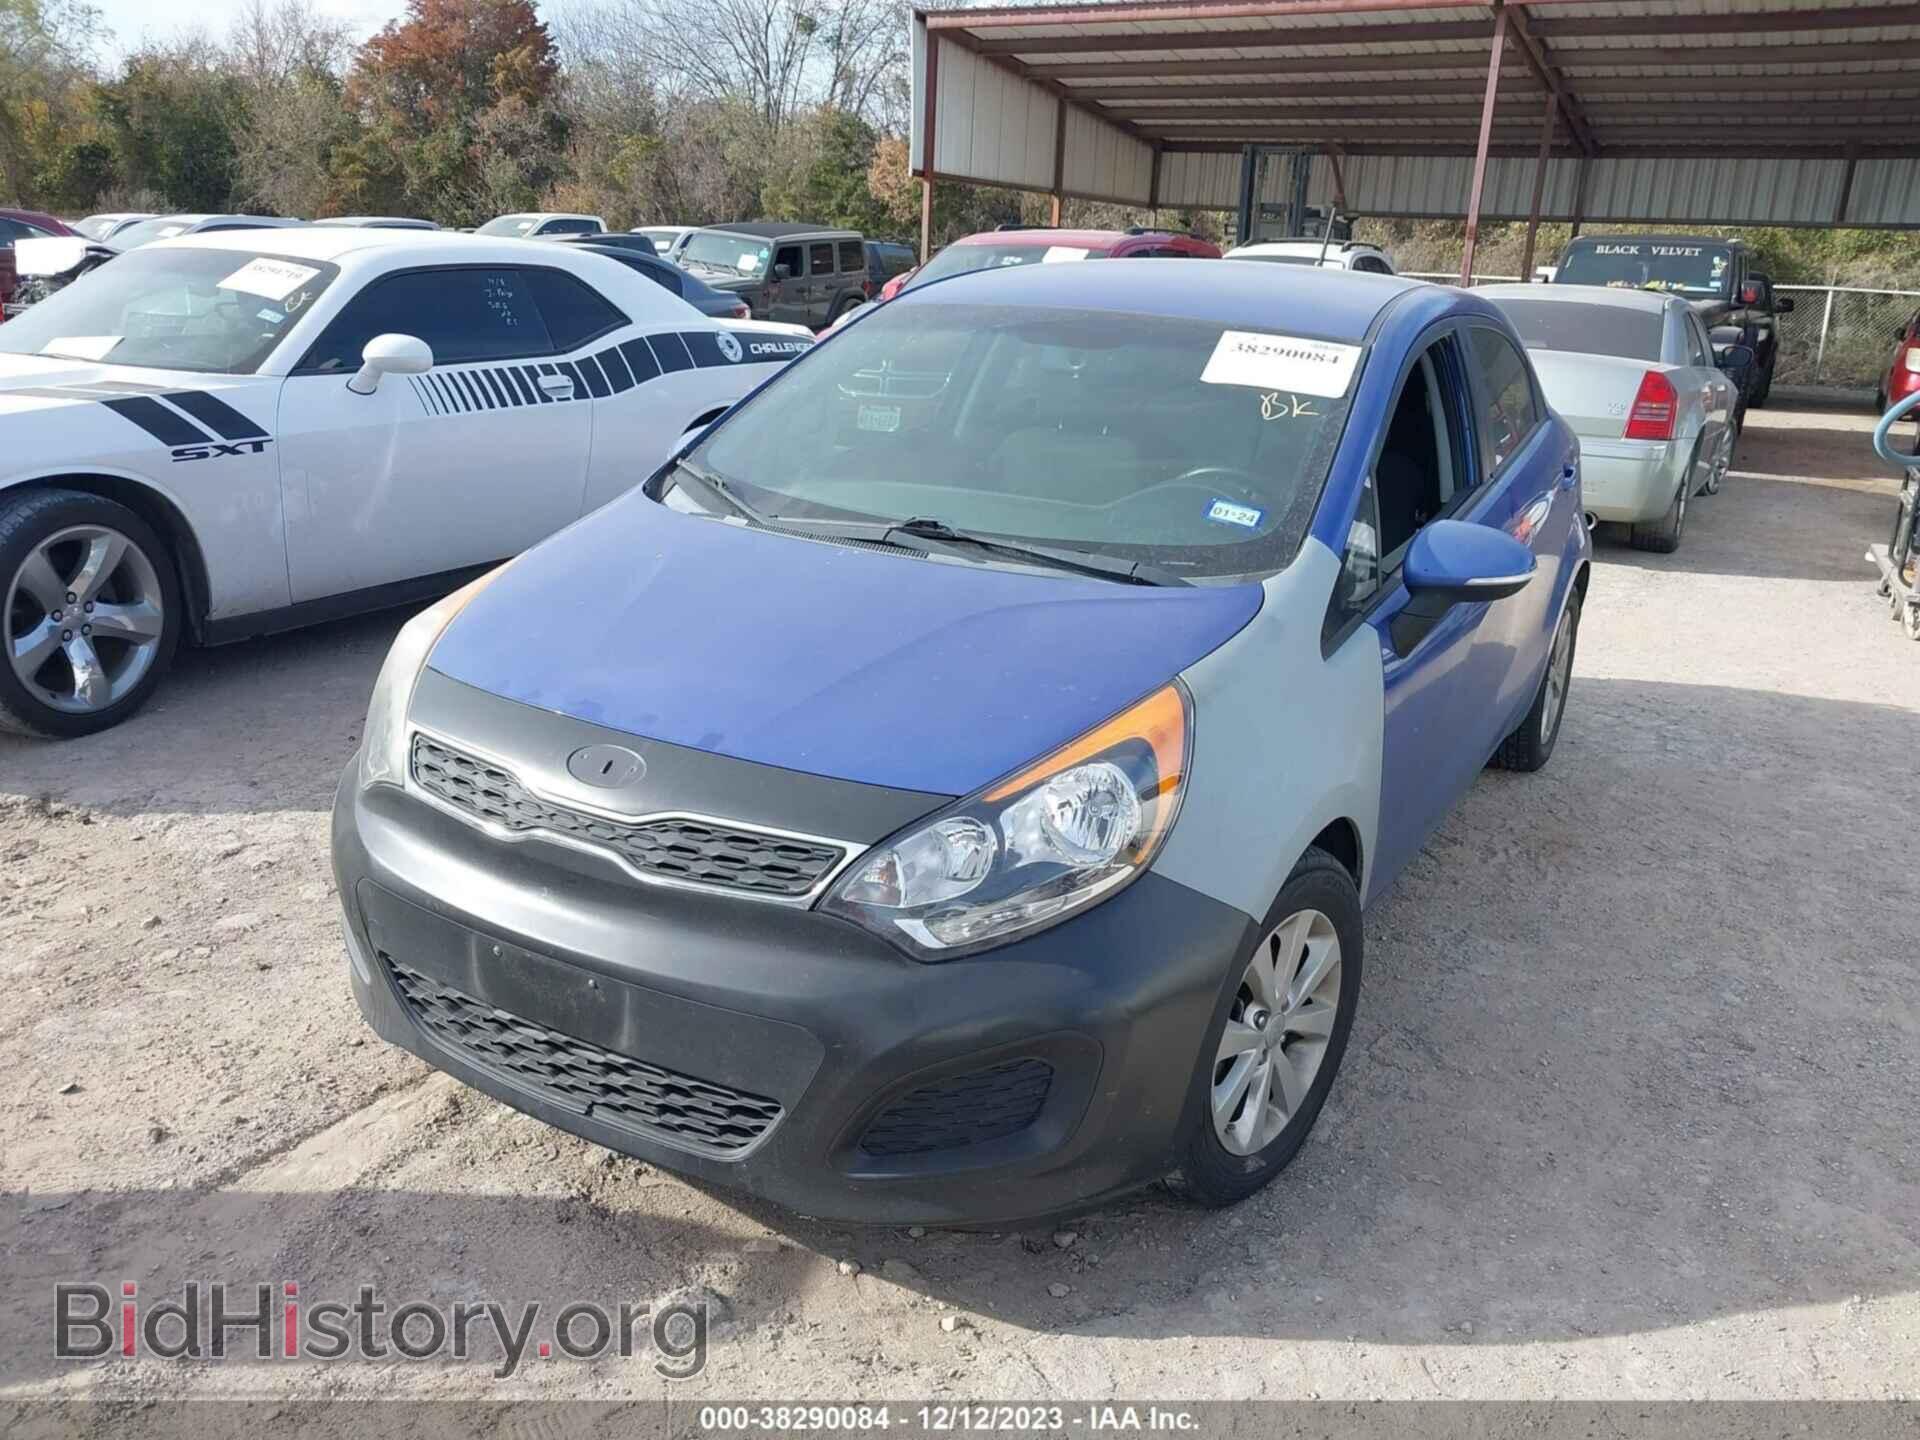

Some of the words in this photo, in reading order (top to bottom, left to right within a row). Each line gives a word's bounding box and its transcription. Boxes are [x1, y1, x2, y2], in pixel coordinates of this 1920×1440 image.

[1595, 244, 1640, 255] BLACK
[1651, 245, 1702, 257] VELVET
[1231, 343, 1340, 365] 38290084
[171, 439, 273, 463] SXT
